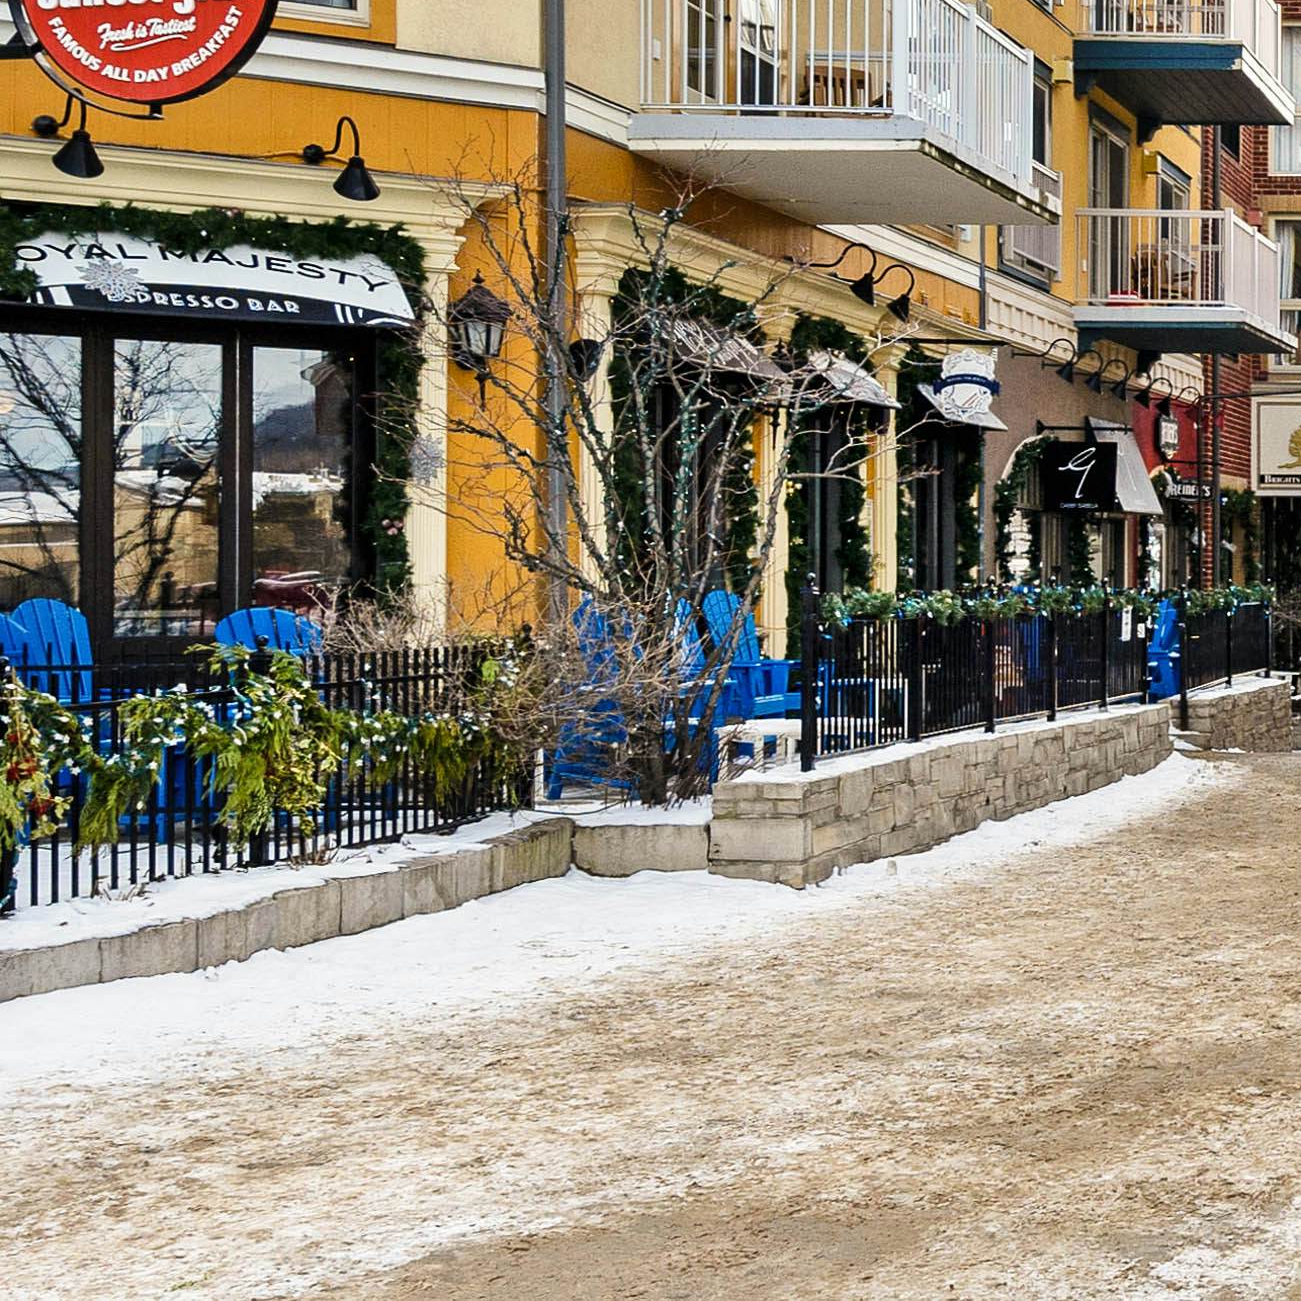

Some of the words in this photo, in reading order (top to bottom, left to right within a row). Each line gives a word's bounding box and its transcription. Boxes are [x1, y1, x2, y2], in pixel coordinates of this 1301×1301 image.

[48, 16, 102, 71] FAMOUS
[101, 64, 131, 82] ALL
[134, 65, 170, 83] DAY
[171, 5, 244, 77] BREAKFAST
[97, 23, 136, 49] Fresh
[135, 26, 149, 39] is
[149, 16, 196, 37] Tastiest
[14, 242, 147, 262] OYAL
[159, 244, 388, 292] MAJESTY
[107, 291, 239, 311] ESPRESSO
[249, 299, 300, 314] BAR
